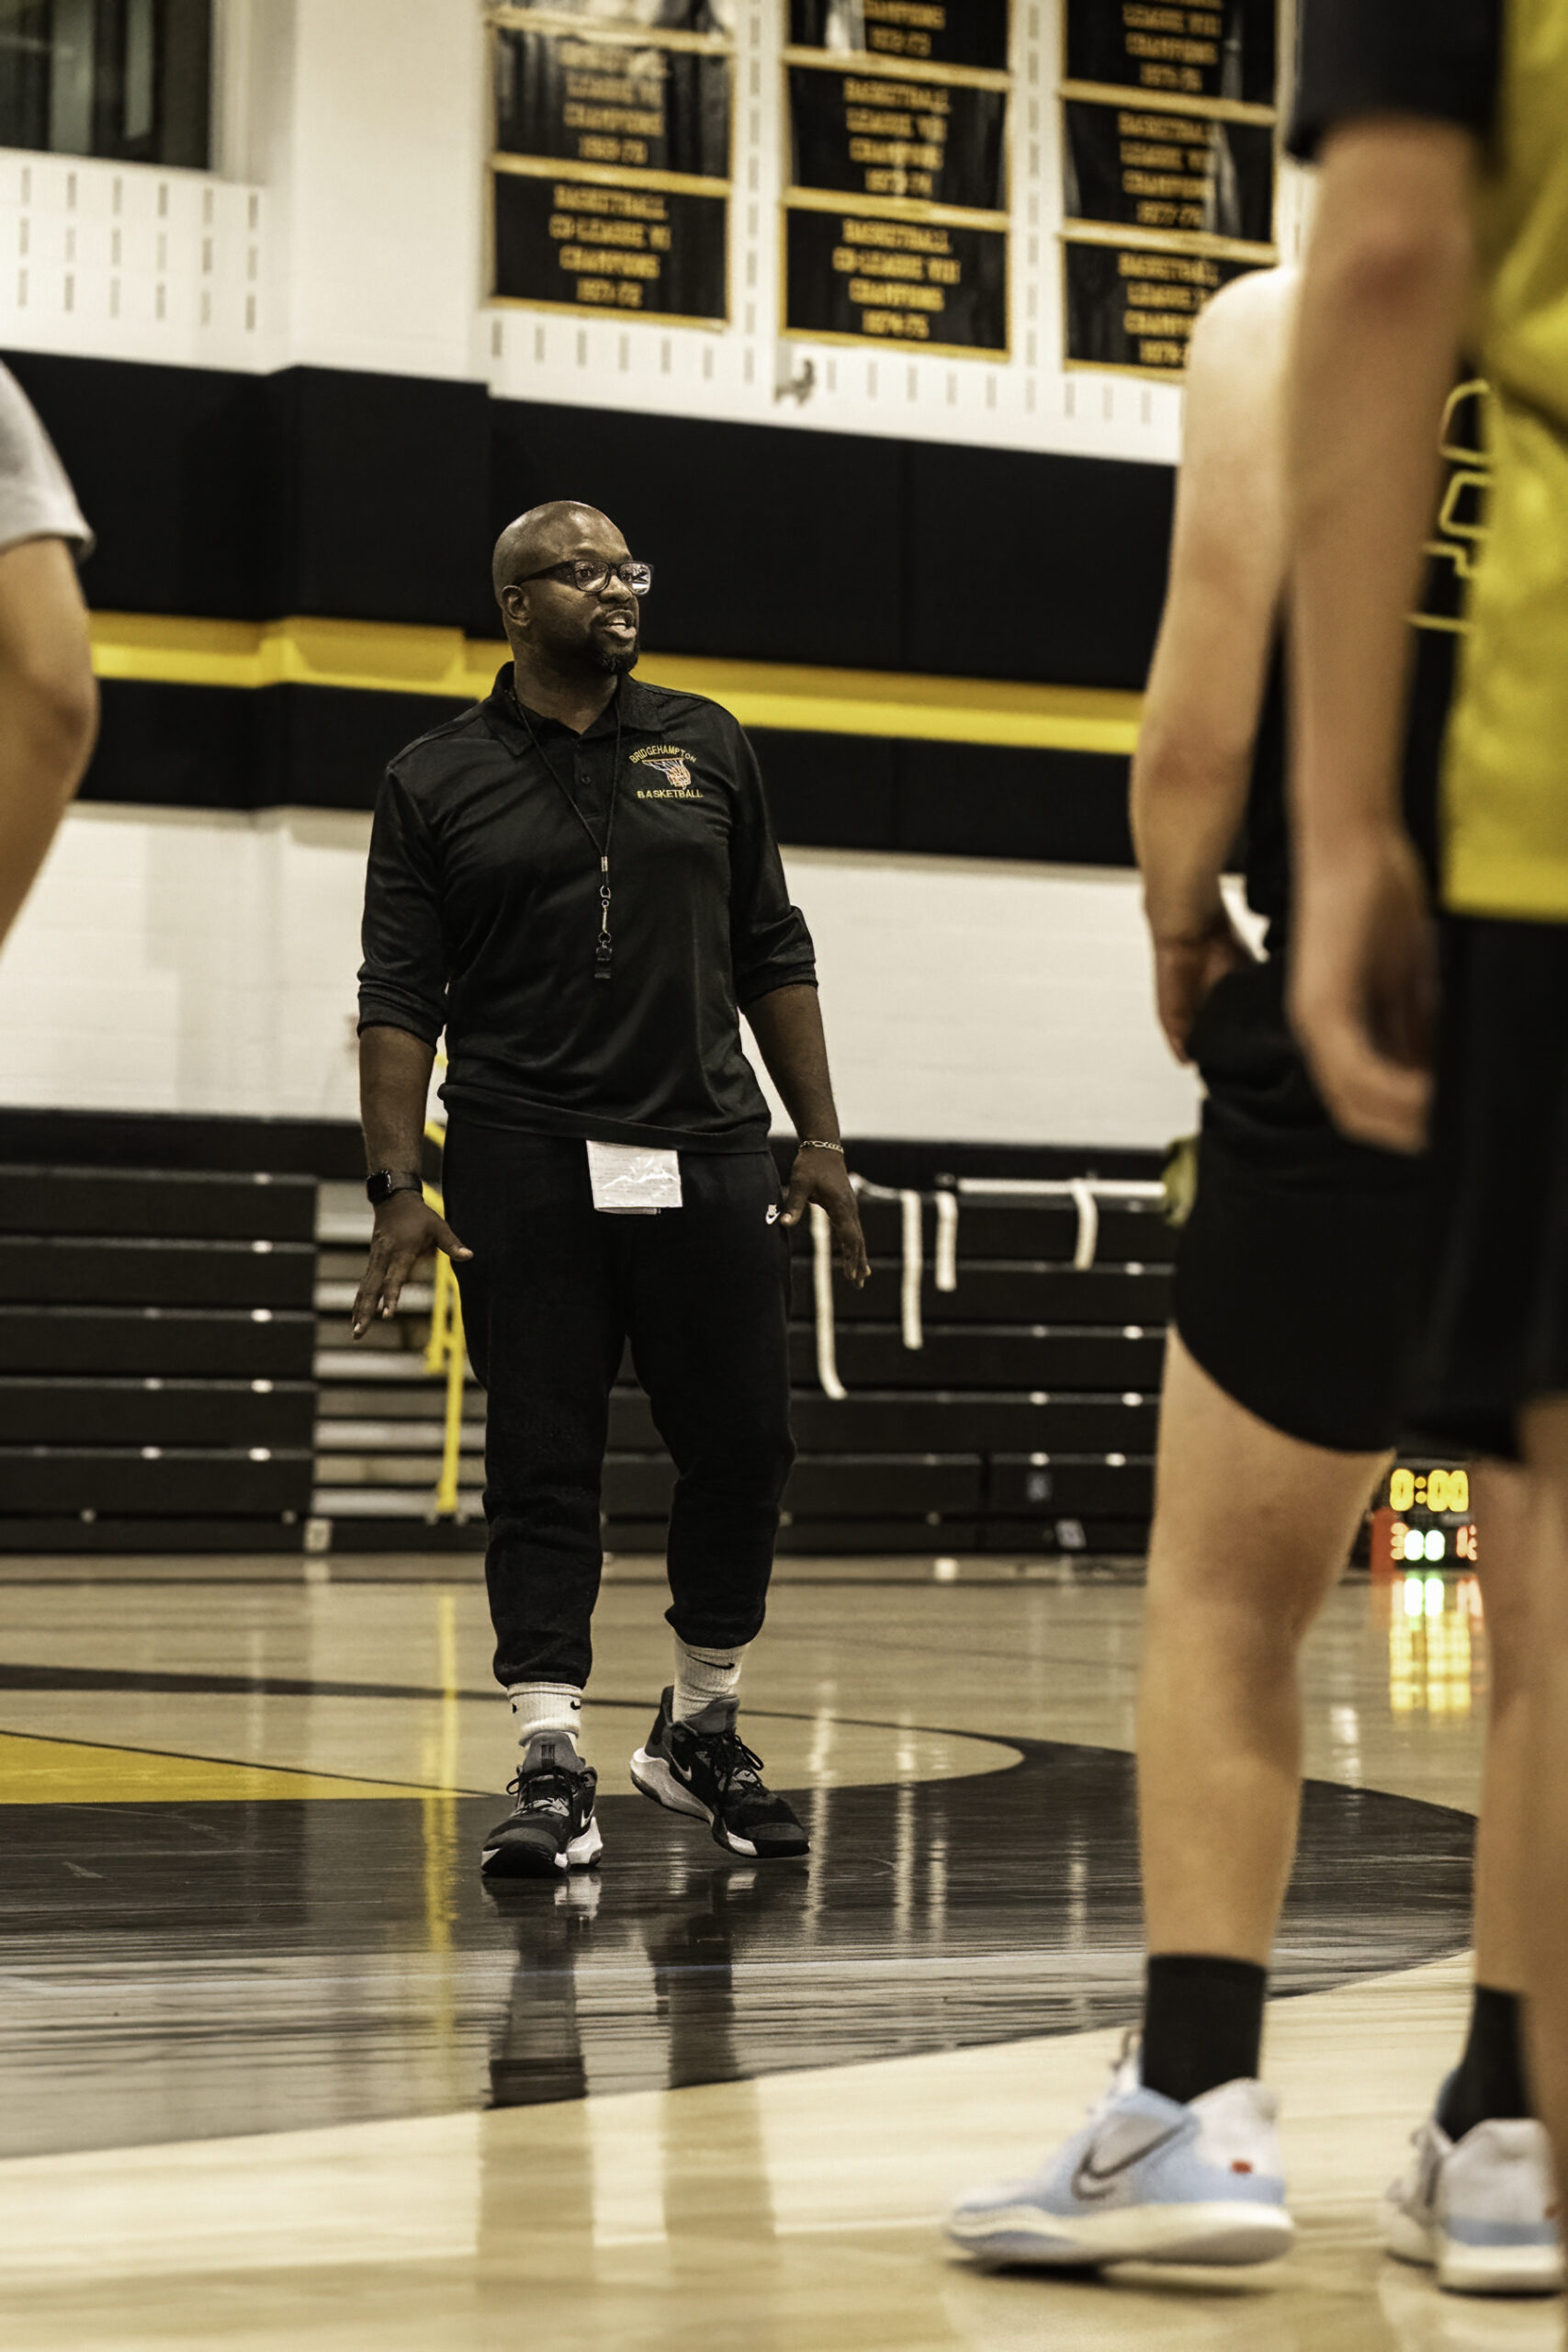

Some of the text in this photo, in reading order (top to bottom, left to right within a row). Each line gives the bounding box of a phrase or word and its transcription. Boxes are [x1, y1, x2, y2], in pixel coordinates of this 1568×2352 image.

[863, 0, 946, 30] HAMPIONS
[1125, 32, 1218, 65] CHAMPIONS
[843, 77, 952, 114] BASKETBALL
[553, 185, 669, 220] BASKETBALL
[842, 219, 953, 254] BASKETBALL
[558, 244, 660, 279] CHAMPIONS
[849, 277, 945, 311] CHAMPIONS
[628, 745, 697, 763] BRIDGEHAMPTON
[637, 789, 704, 799] BASKETBALL
